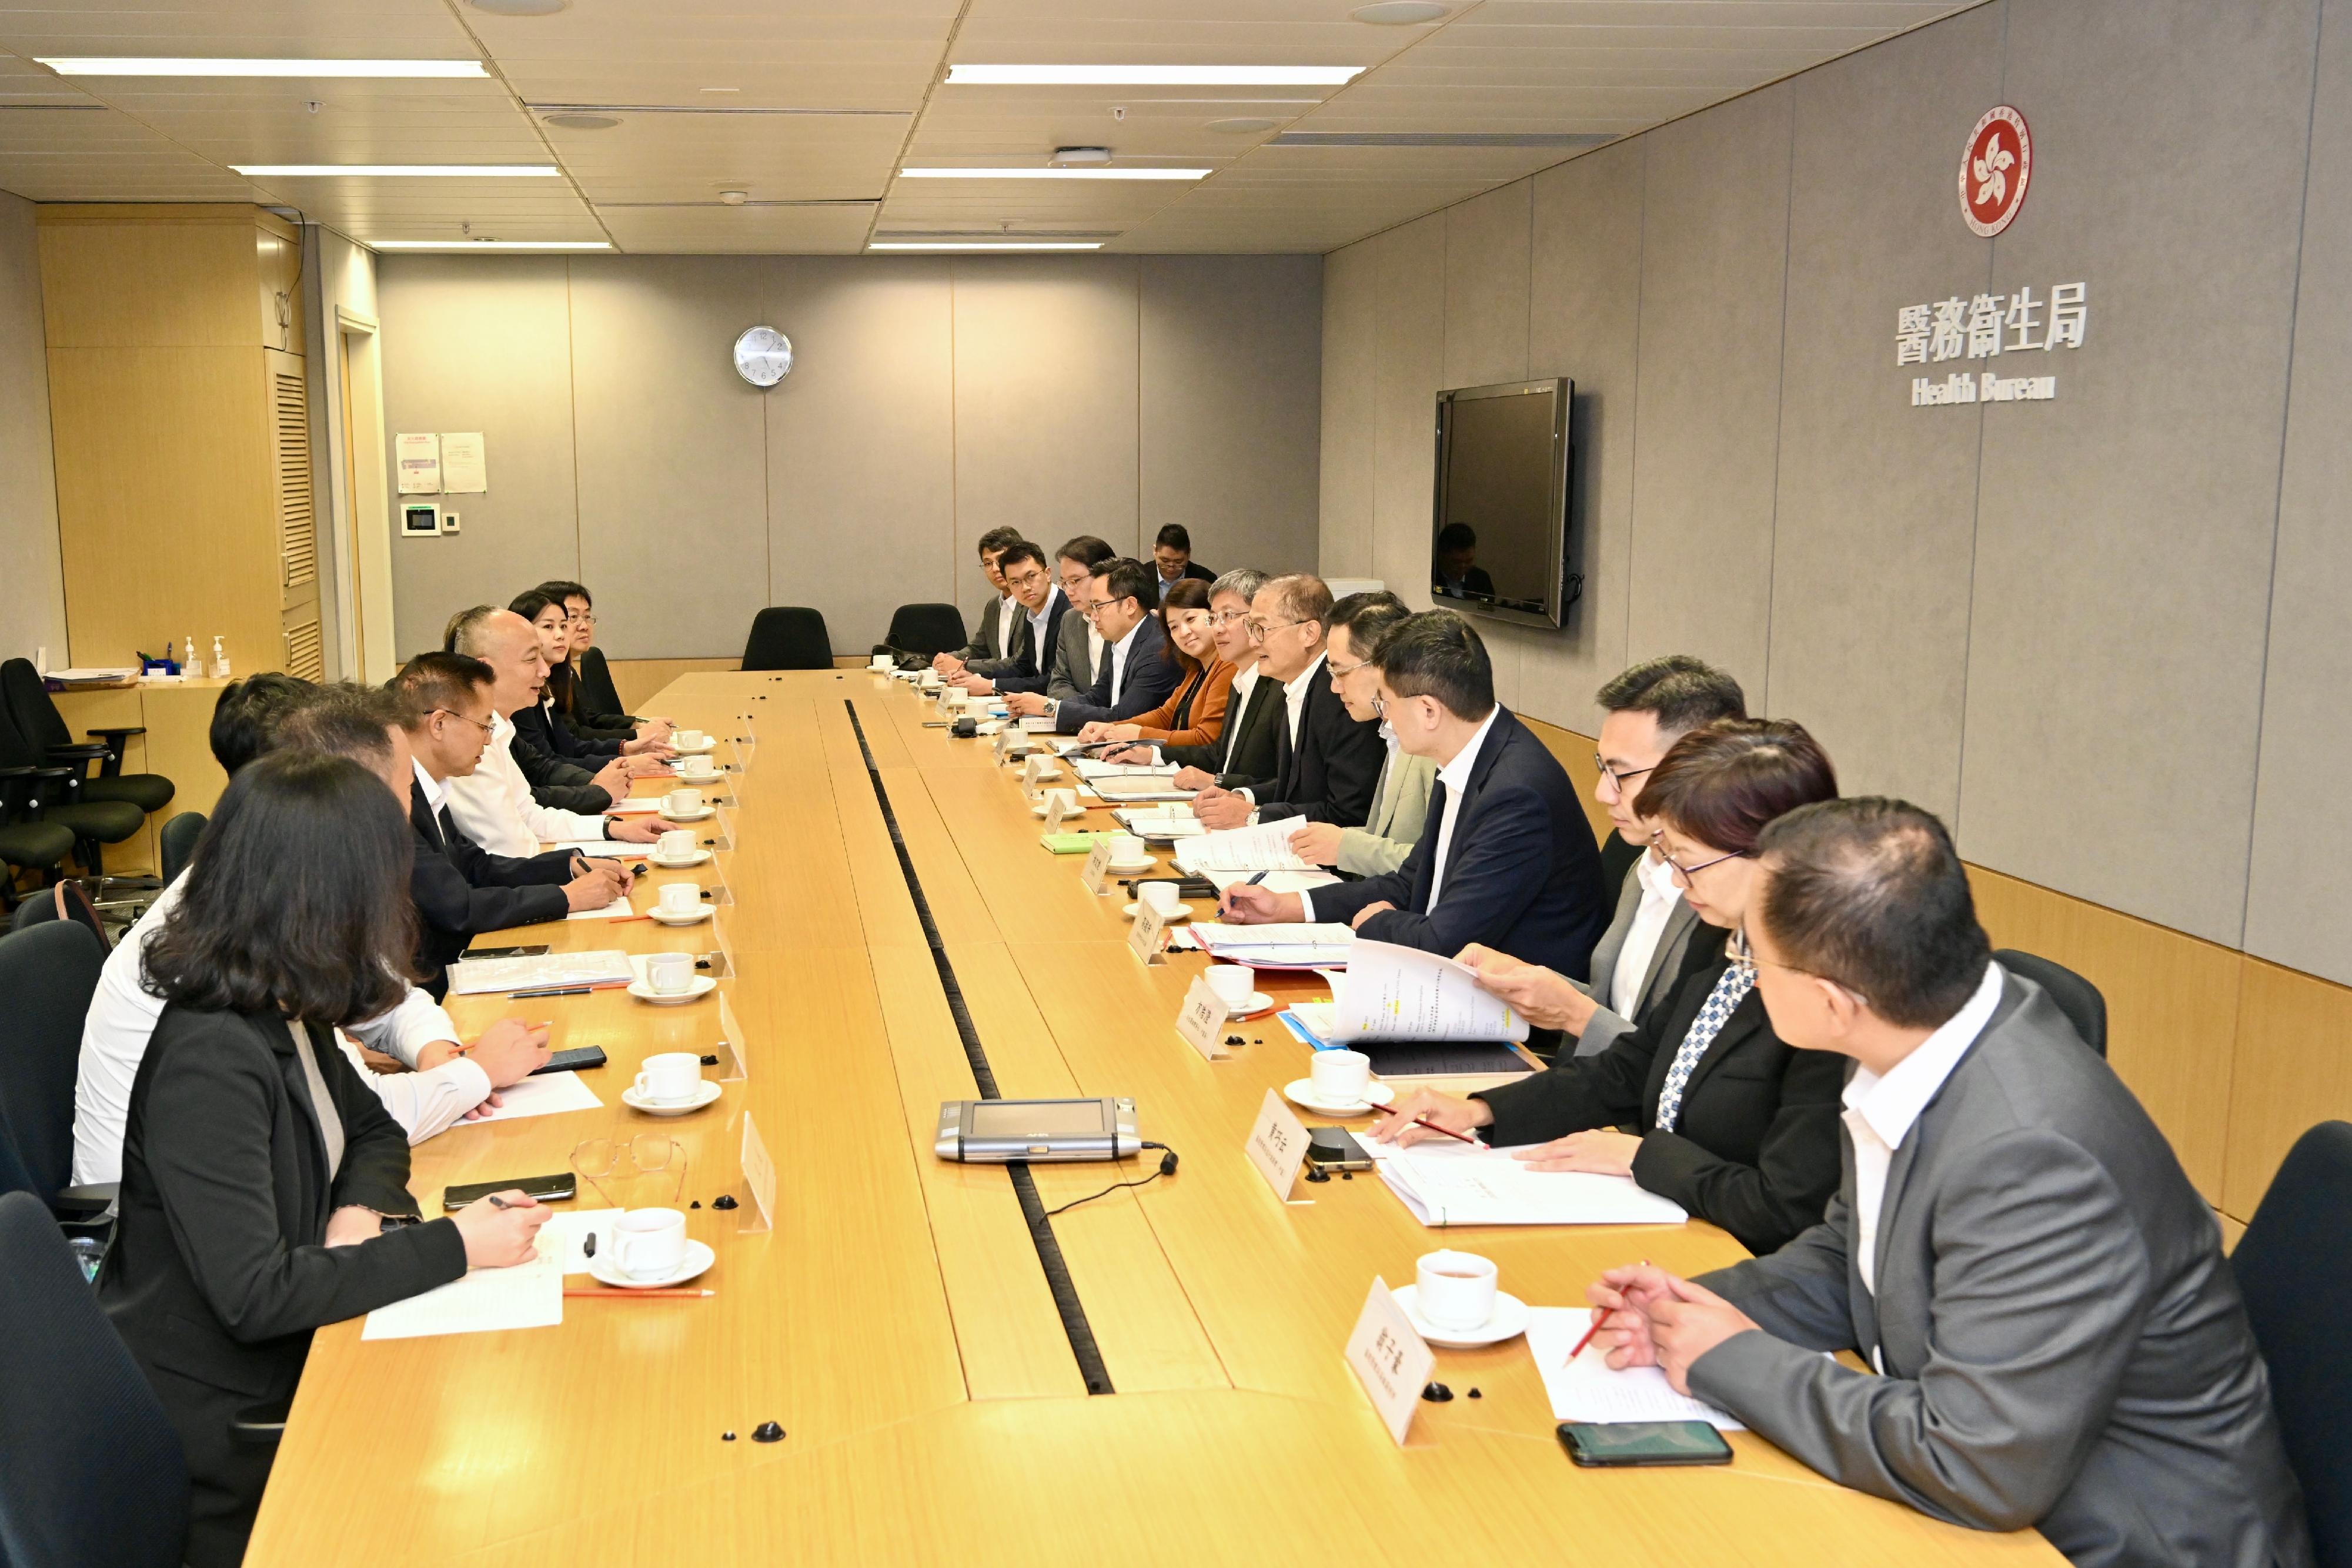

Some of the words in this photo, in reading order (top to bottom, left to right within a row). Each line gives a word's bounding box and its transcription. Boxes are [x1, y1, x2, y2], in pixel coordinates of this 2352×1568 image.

[1970, 219, 1989, 235] HONG
[1991, 212, 2012, 233] KONG
[1912, 373, 1976, 406] Health
[1980, 372, 2056, 402] Bureau
